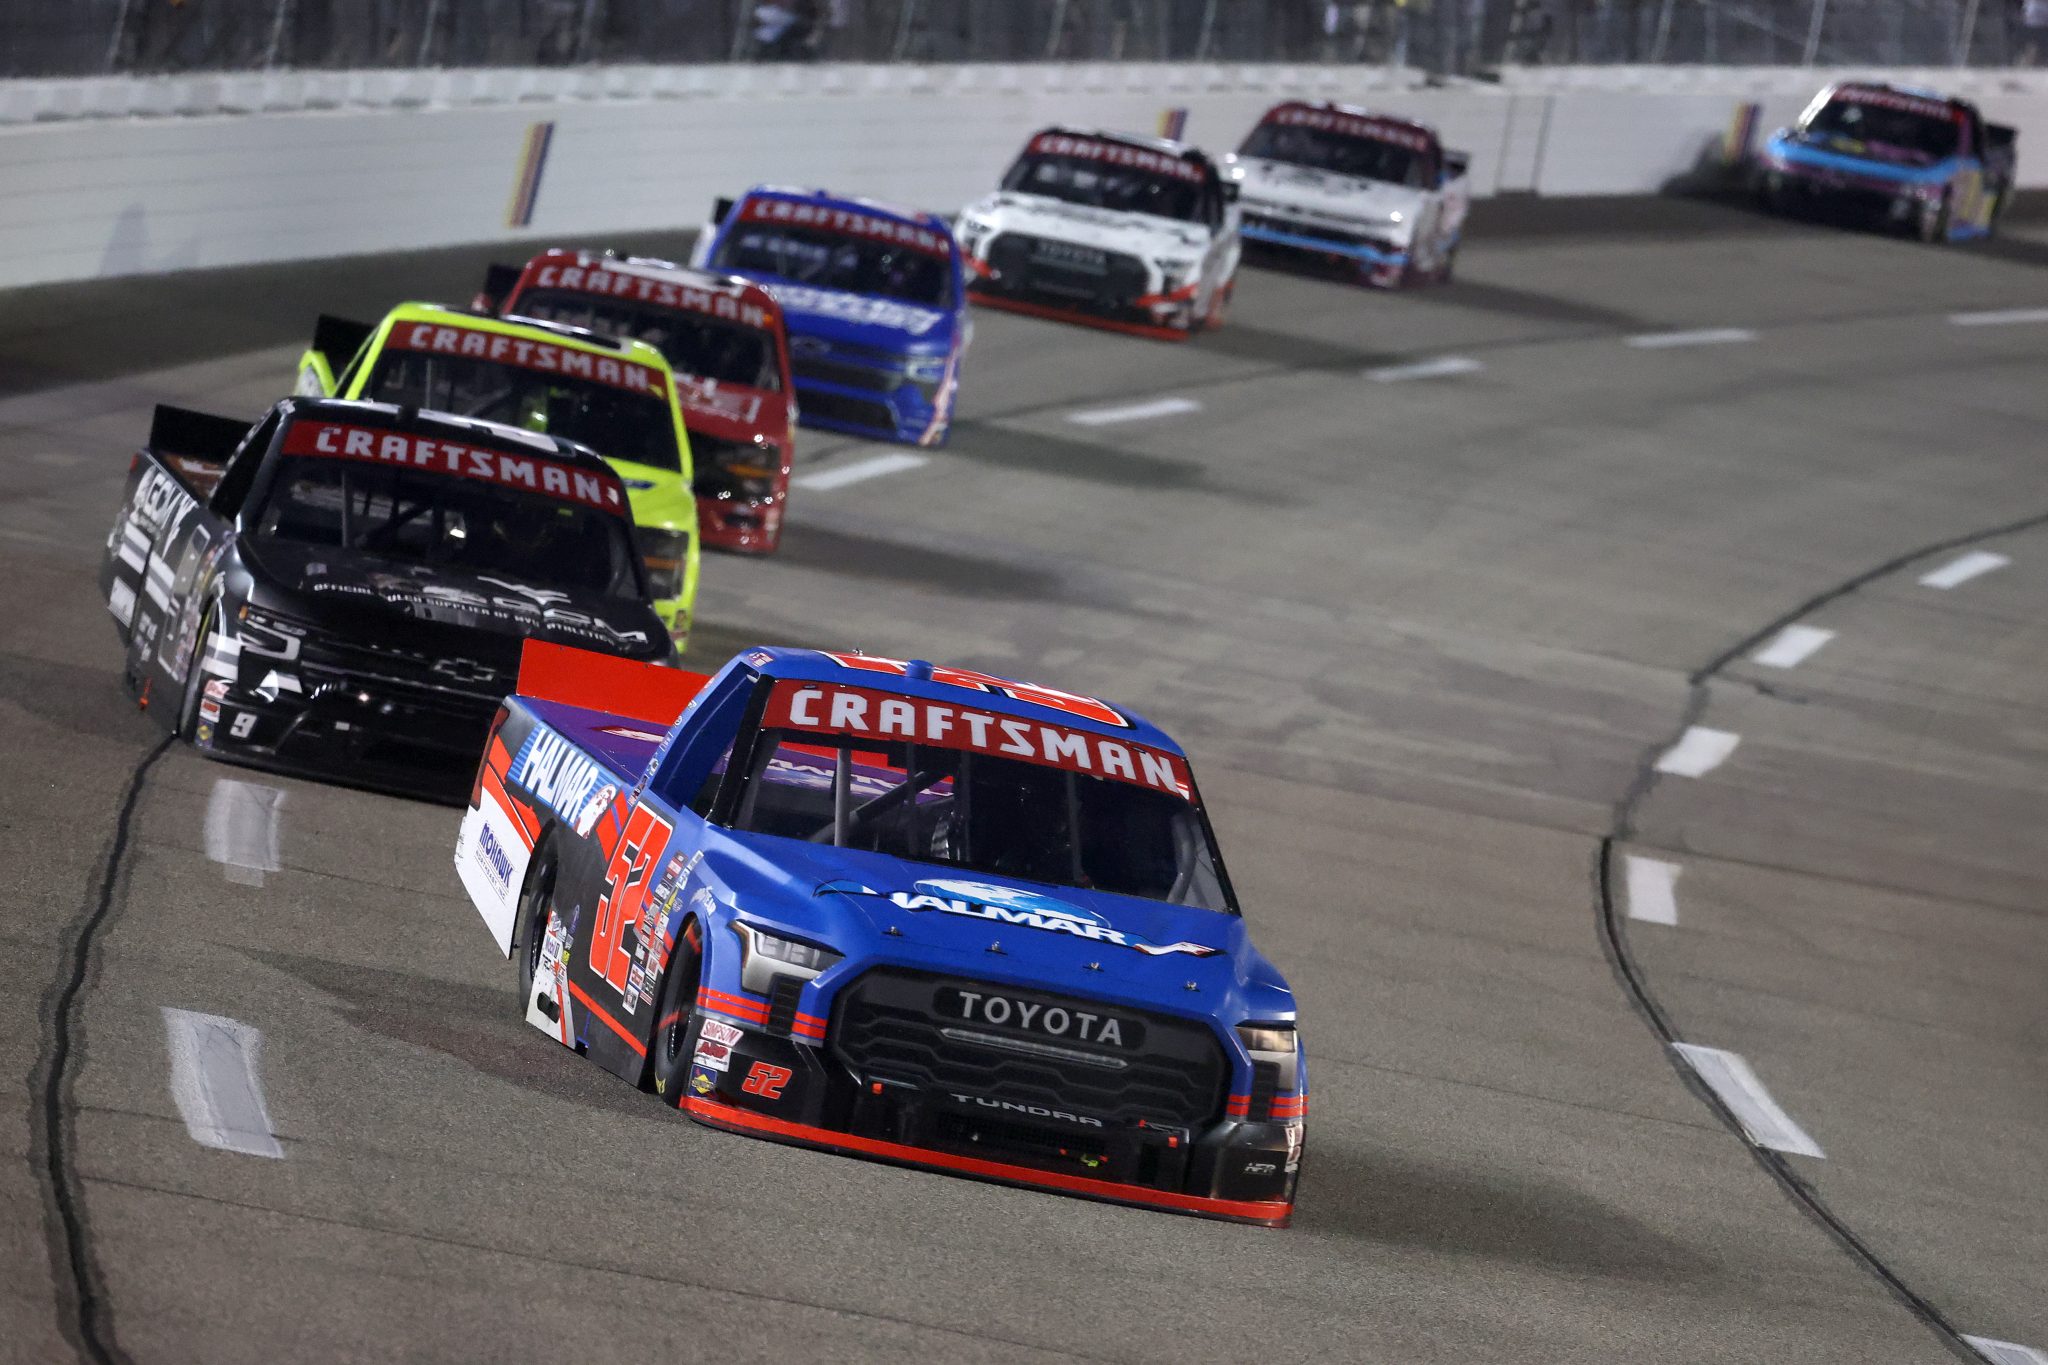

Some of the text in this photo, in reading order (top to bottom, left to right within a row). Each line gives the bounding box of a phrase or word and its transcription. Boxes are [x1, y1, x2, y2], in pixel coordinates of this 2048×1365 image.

[755, 201, 937, 249] CRAFTSMAN
[536, 265, 765, 328] CRAFTSMAN
[409, 324, 648, 390] CRAFTSMAN
[316, 426, 601, 503] CRAFTSMAN
[230, 712, 258, 738] 9
[789, 688, 1180, 794] CRAFTSMAN
[518, 726, 599, 825] HALMAR
[480, 822, 513, 889] MOHAWK
[588, 800, 674, 996] 52
[958, 991, 1123, 1048] TOYOTA
[741, 1060, 793, 1100] 52
[951, 1092, 1103, 1128] TUNDRA
